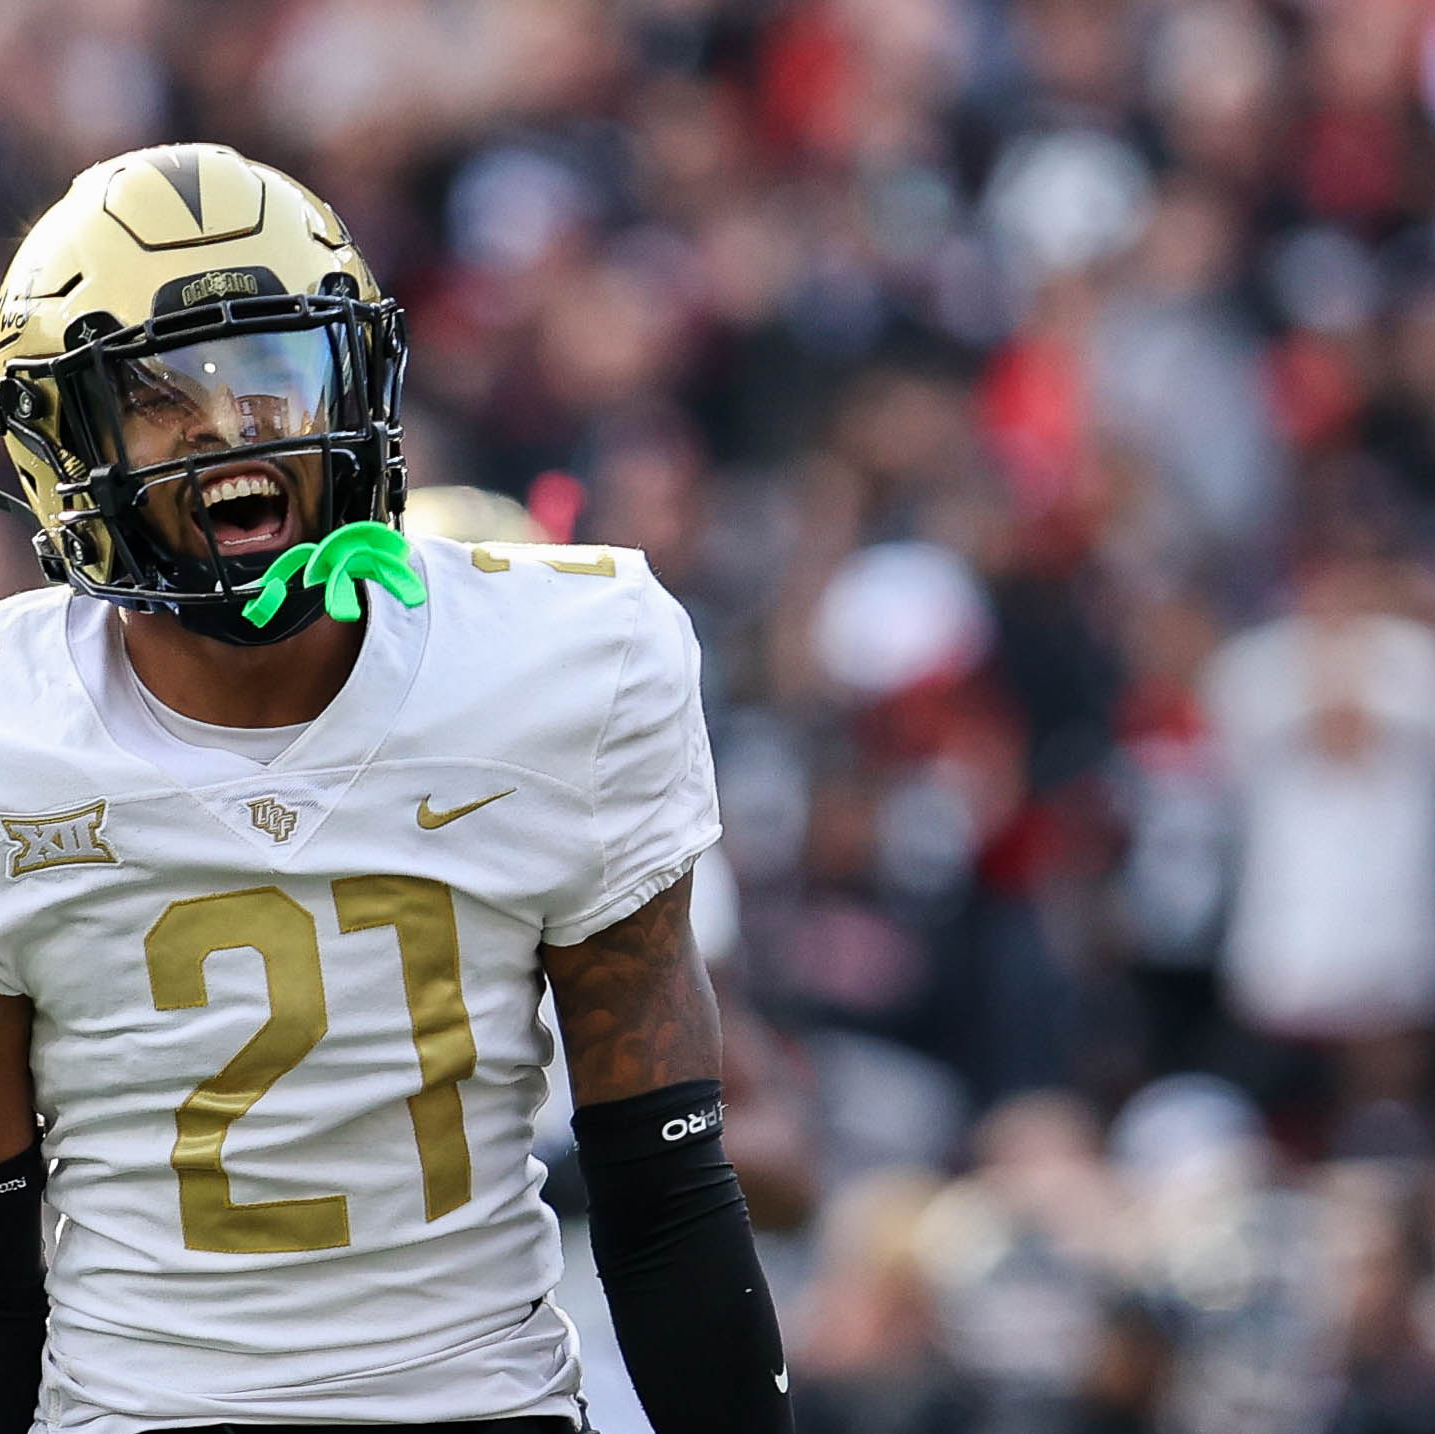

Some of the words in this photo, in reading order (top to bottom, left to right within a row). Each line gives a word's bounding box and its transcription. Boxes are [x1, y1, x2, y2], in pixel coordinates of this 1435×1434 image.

[181, 271, 259, 307] ORLNDO
[246, 797, 298, 842] UCF
[143, 874, 477, 1254] 21
